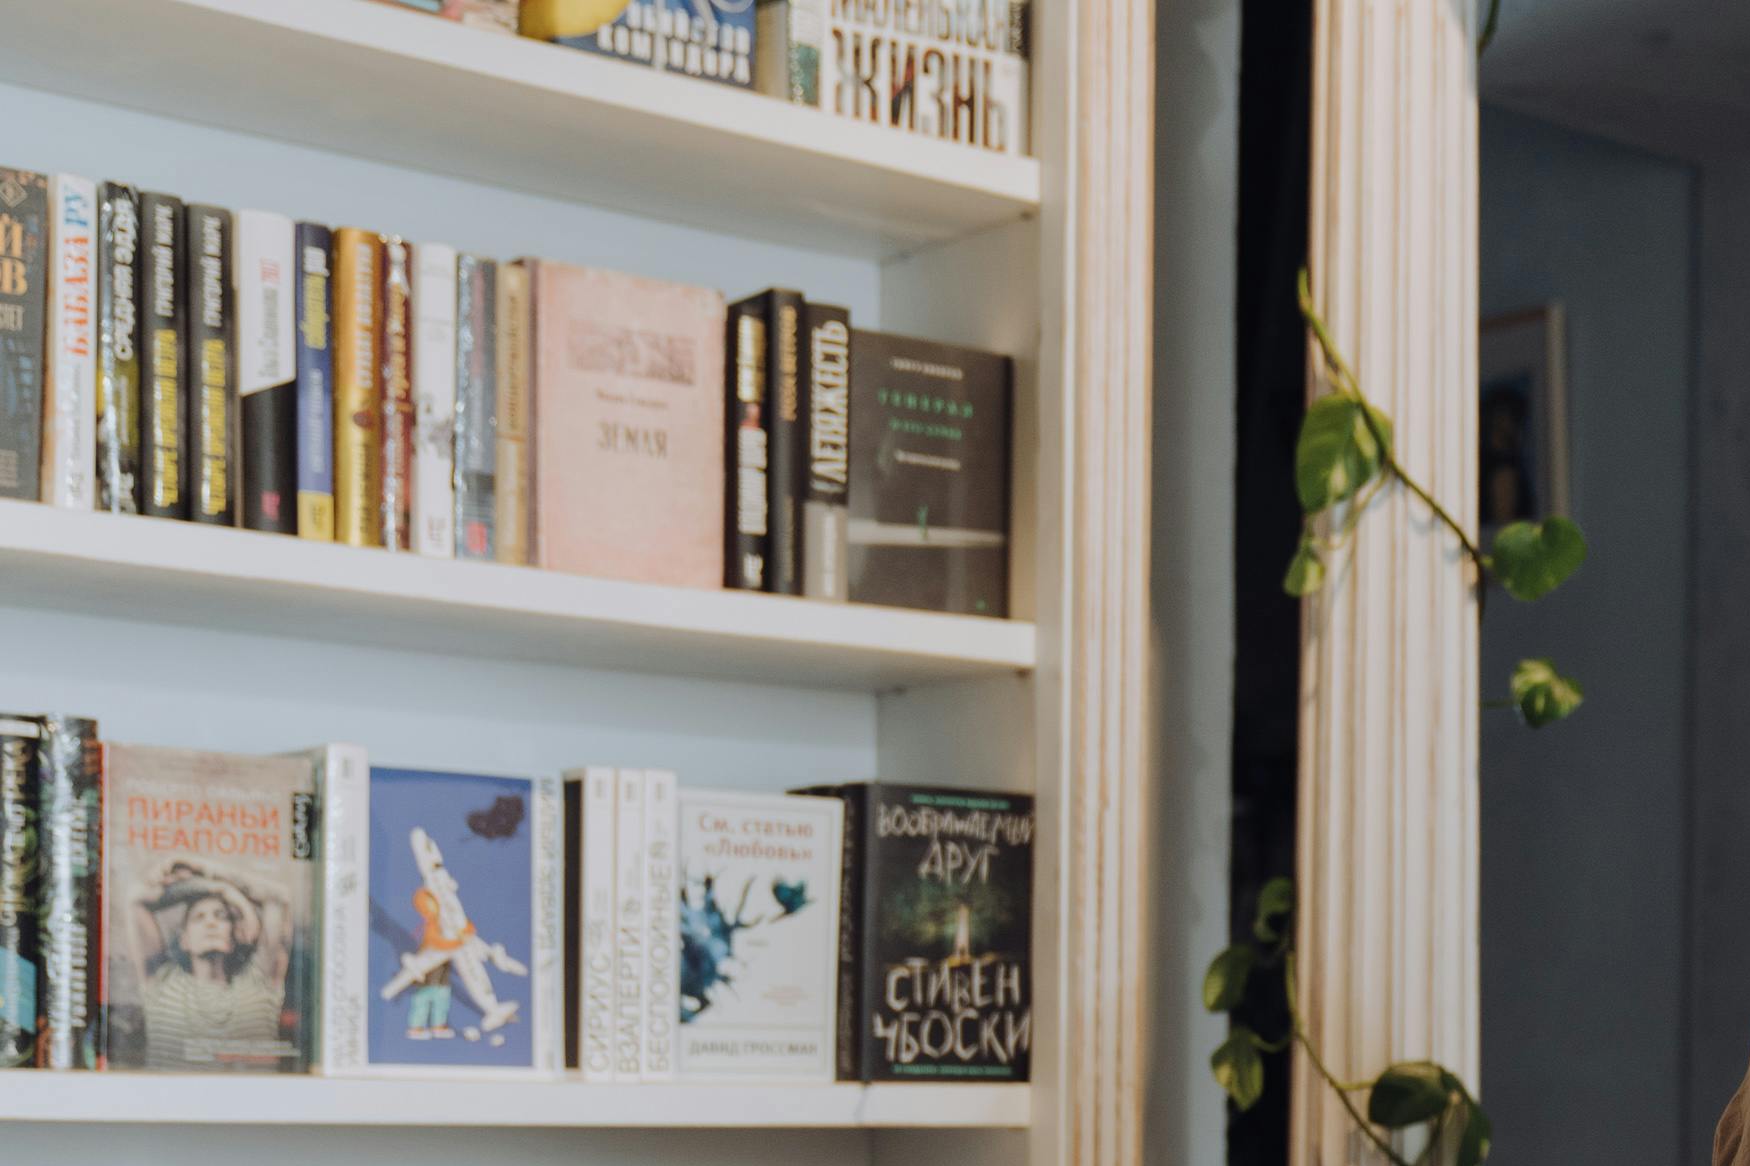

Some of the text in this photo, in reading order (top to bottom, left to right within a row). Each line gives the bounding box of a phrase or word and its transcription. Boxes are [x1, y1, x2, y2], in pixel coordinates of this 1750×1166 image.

[831, 27, 1007, 153] ЖИЗНЬ
[810, 319, 849, 485] ЛЕТЯЖЕСТЬ
[597, 421, 668, 460] ЗЕМЛЯ
[127, 796, 281, 831] ПИРАНЬИ
[741, 819, 813, 839] статью
[127, 825, 281, 858] НЕАПОЛЯ
[917, 842, 998, 885] ДРУГ
[589, 952, 612, 1072] СИРИУС
[619, 925, 641, 1074] ВЗАПЕРТИ
[885, 956, 1021, 1015] СТИВЕН
[872, 1008, 1033, 1063] ЧБОСКИ
